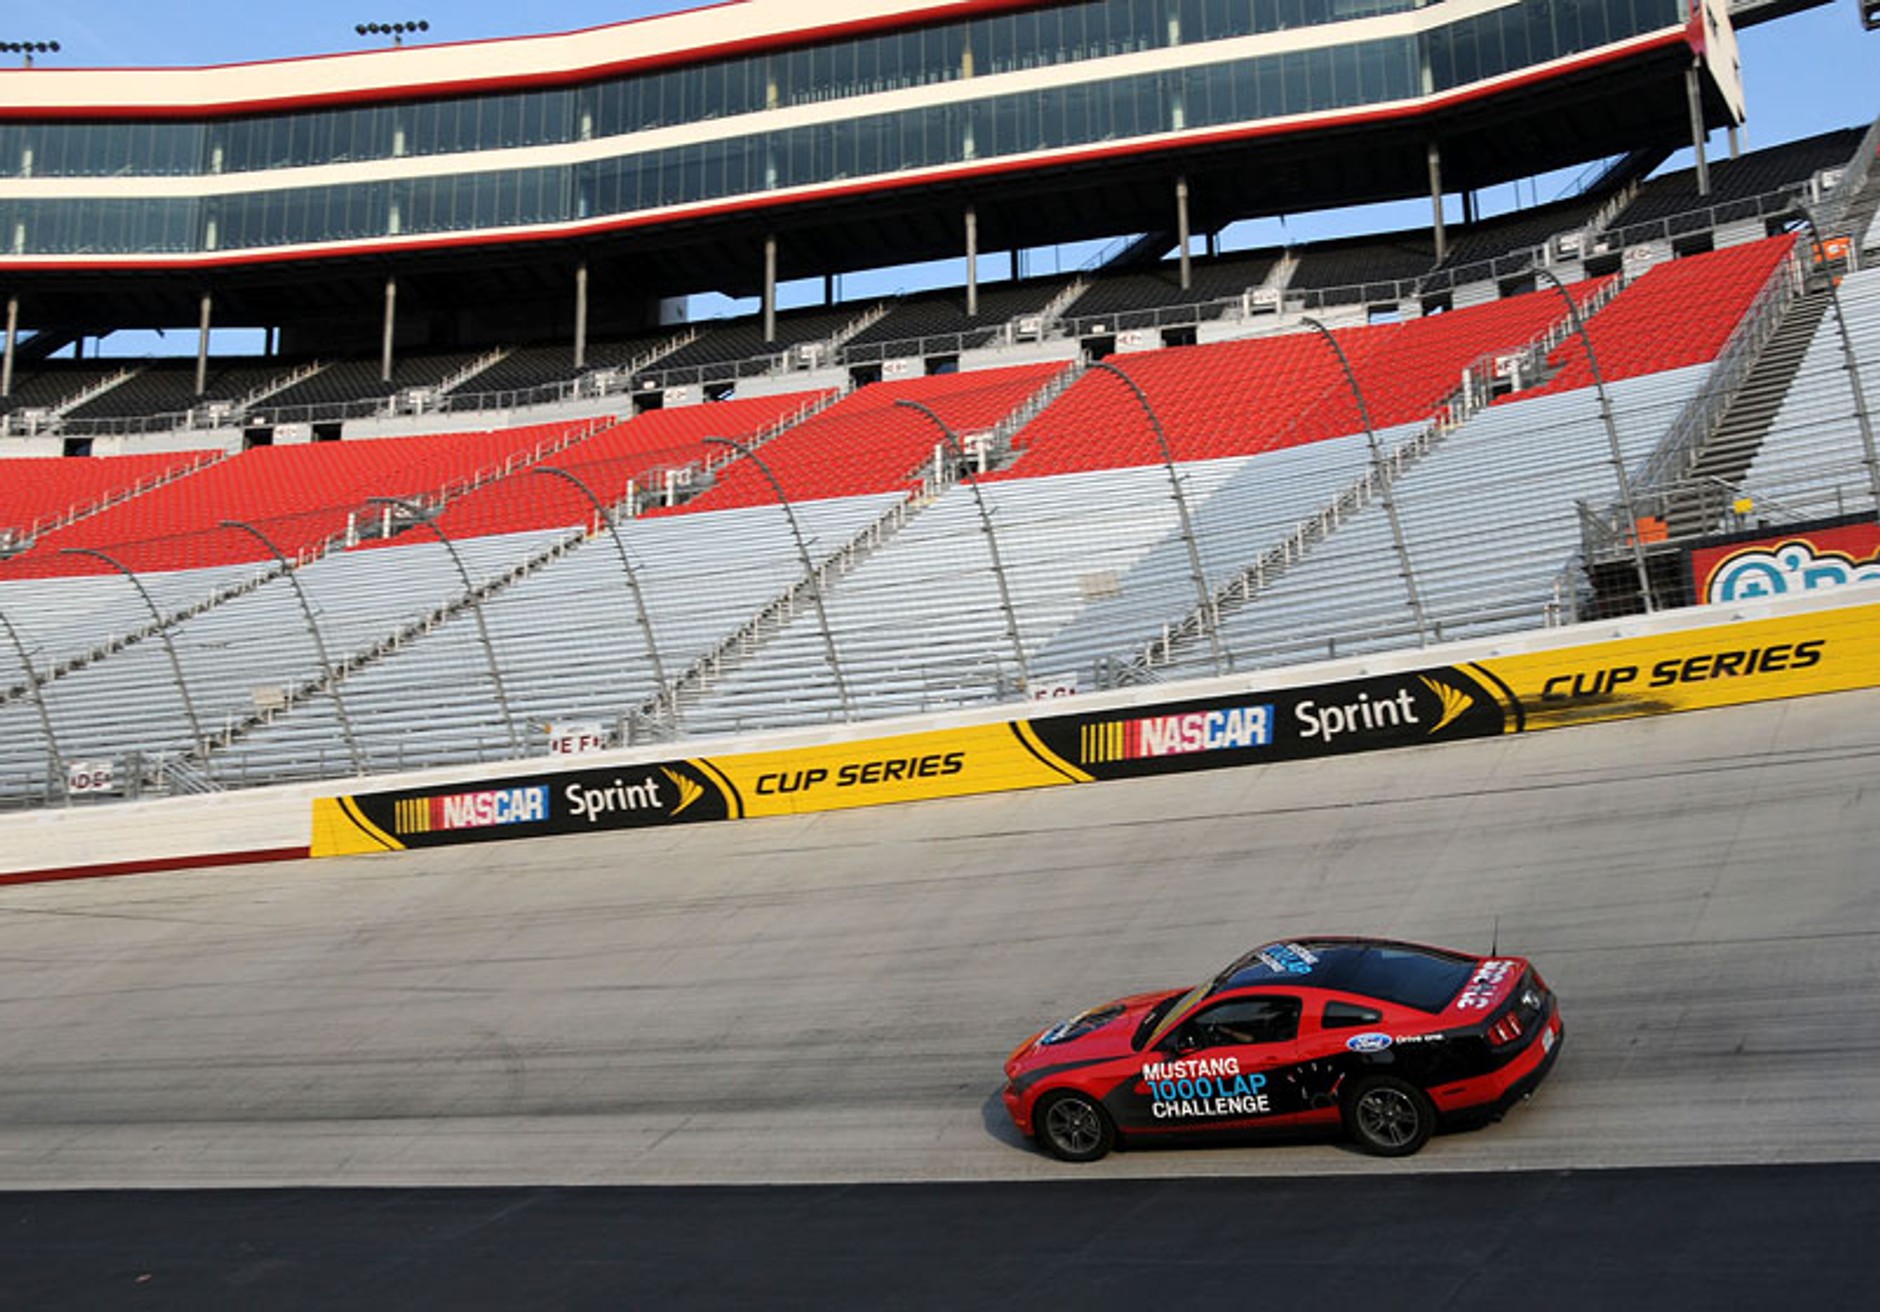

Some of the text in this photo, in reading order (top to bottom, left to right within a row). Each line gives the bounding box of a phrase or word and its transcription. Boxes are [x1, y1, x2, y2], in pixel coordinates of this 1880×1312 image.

[1543, 639, 1827, 699] CUP SERIES
[1139, 689, 1419, 757] NASCAR Sprint
[755, 752, 966, 795] CUP SERIES
[443, 777, 663, 830] NASCAR Sprint
[1142, 1057, 1240, 1081] MUSTANG
[1147, 1073, 1267, 1101] 1000 LAP
[1152, 1094, 1271, 1118] CHALLENGE
